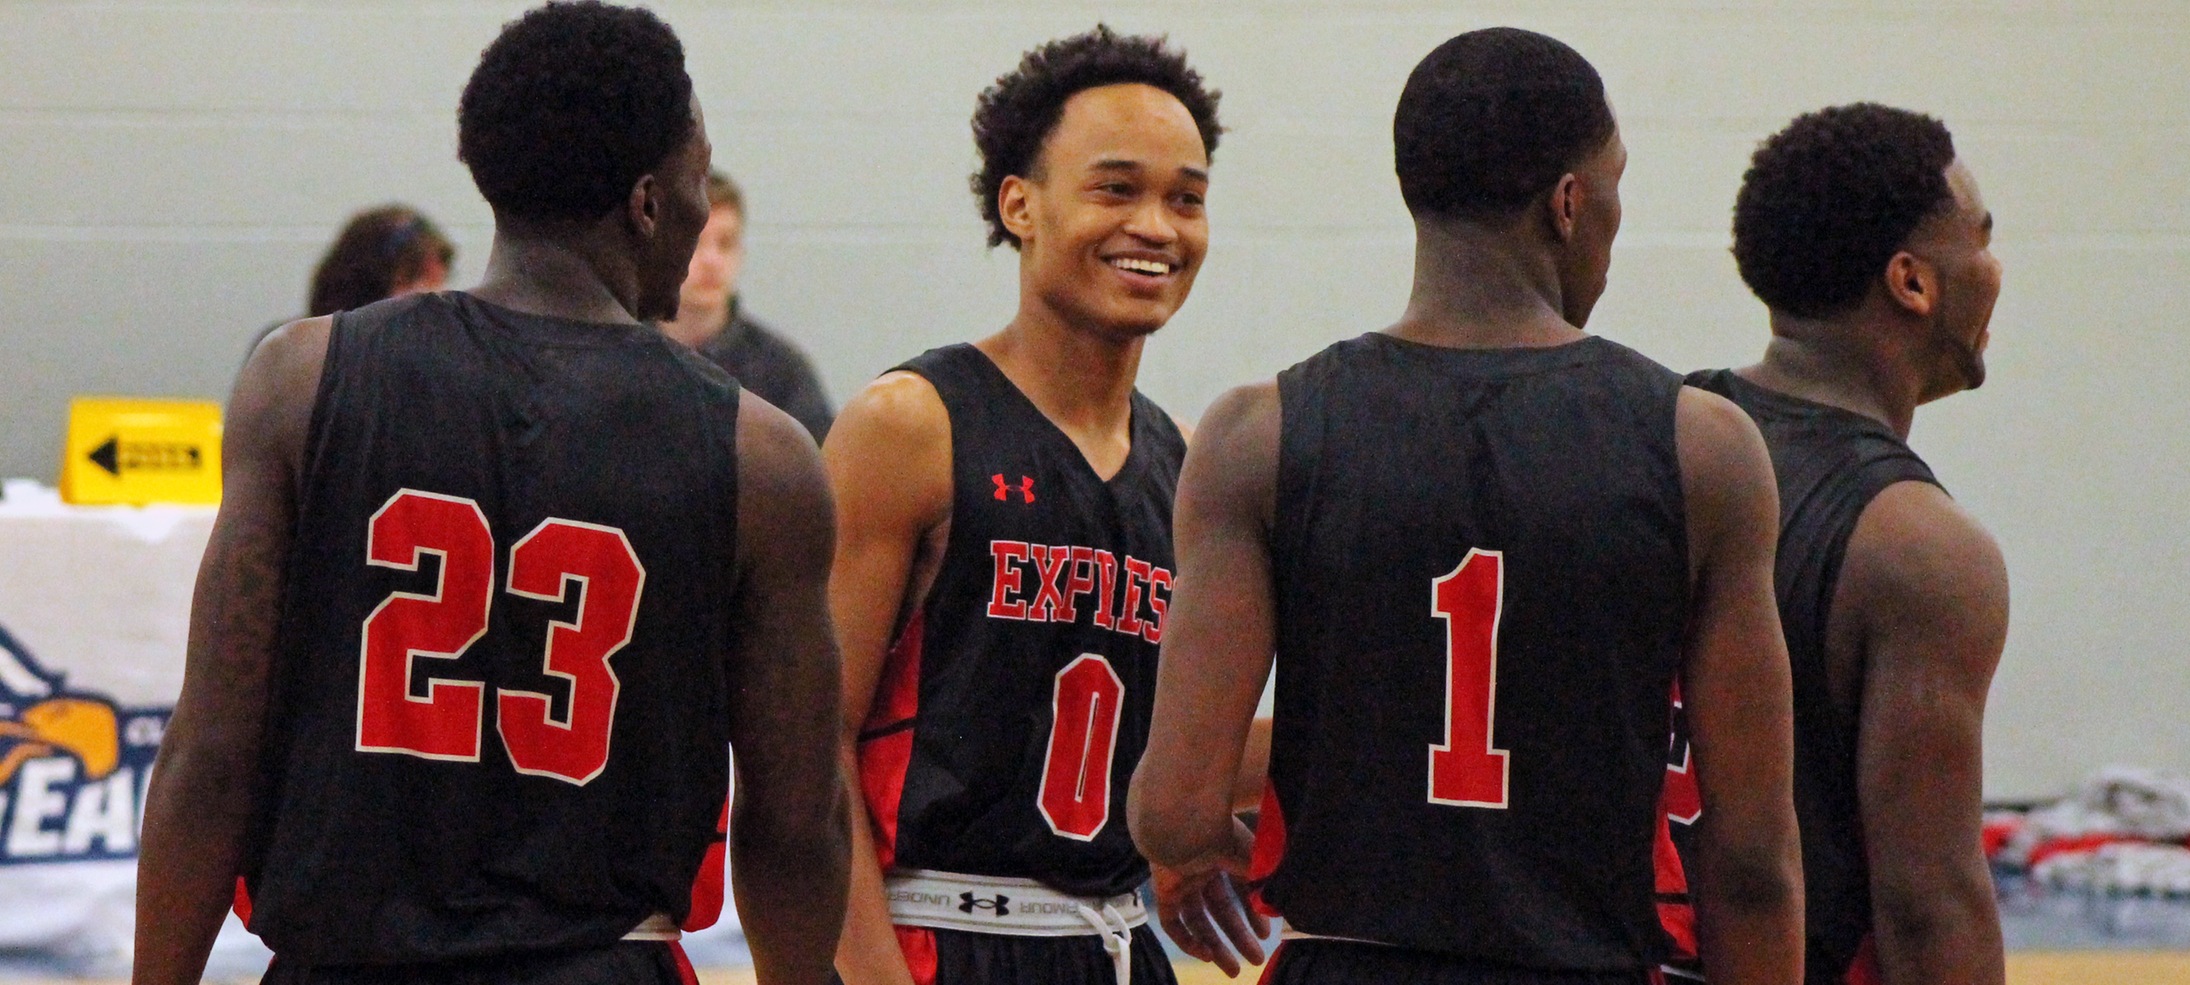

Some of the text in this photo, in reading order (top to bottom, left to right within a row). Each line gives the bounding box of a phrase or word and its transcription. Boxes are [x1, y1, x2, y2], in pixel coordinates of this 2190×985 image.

[355, 487, 647, 787] 23
[987, 540, 1178, 644] EXPRES
[1427, 546, 1510, 809] 1
[1037, 652, 1125, 842] 0
[1020, 901, 1081, 915] RMOUR
